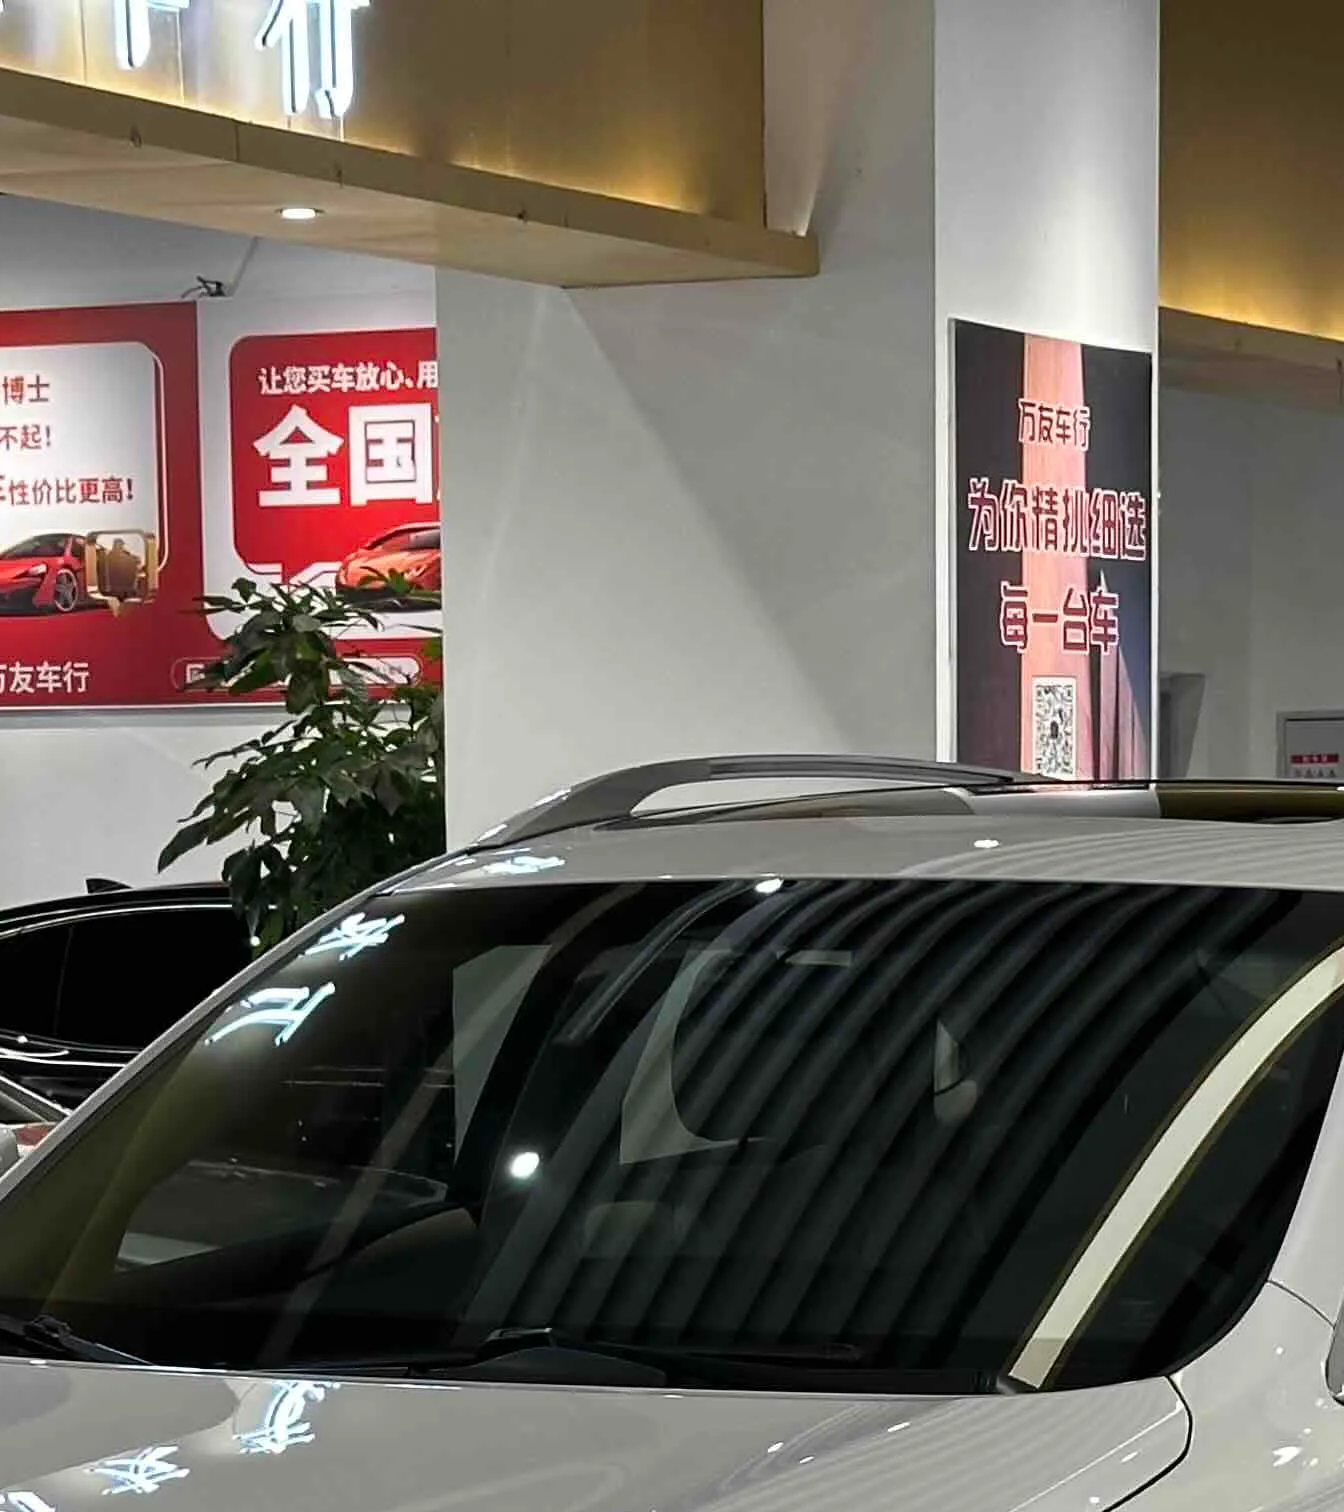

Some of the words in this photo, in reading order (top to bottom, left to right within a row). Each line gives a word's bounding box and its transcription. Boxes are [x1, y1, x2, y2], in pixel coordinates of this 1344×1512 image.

[253, 402, 440, 507] 全国
[1018, 398, 1092, 451] 万友车行
[967, 477, 1147, 561] 为你精挑细选
[998, 580, 1120, 655] 每一台车
